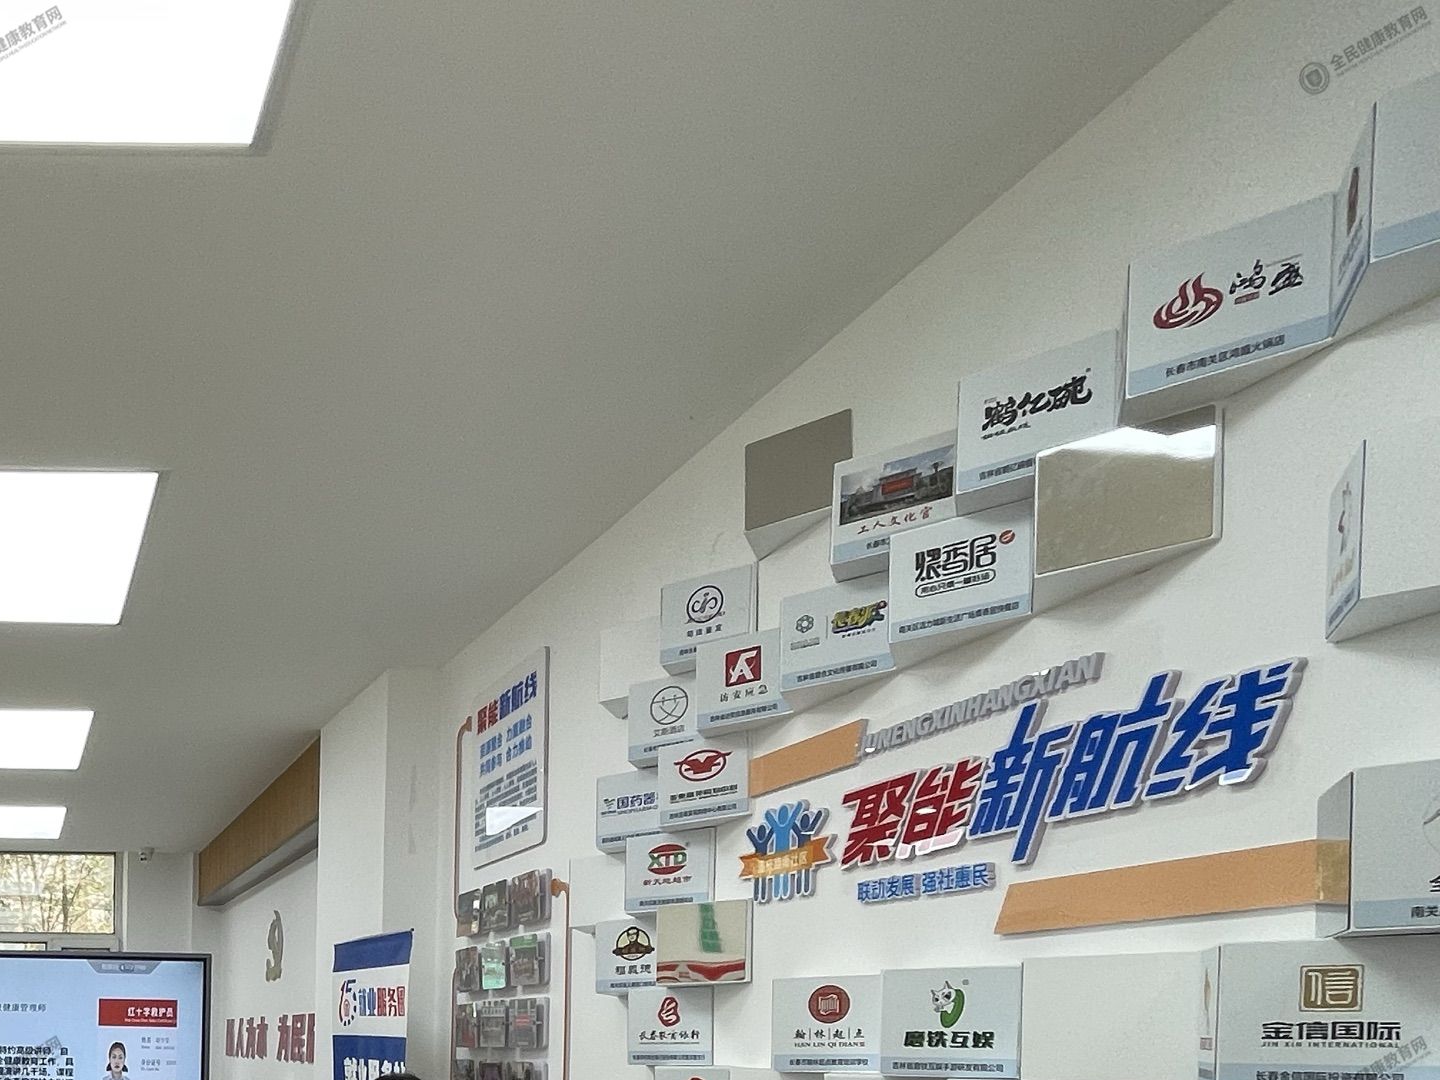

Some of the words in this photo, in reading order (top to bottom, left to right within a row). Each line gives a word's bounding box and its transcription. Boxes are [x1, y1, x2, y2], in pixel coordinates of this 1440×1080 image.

[841, 658, 1302, 868] 聚能新航线
[616, 791, 659, 810] 国药器
[648, 851, 687, 870] XTD
[857, 873, 915, 903] 联动发展
[921, 863, 989, 894] 强社惠民
[903, 1030, 995, 1050] 磨铁互娱
[1260, 1021, 1402, 1041] 金信国际
[1308, 1041, 1401, 1049] INTERNATIONAL
